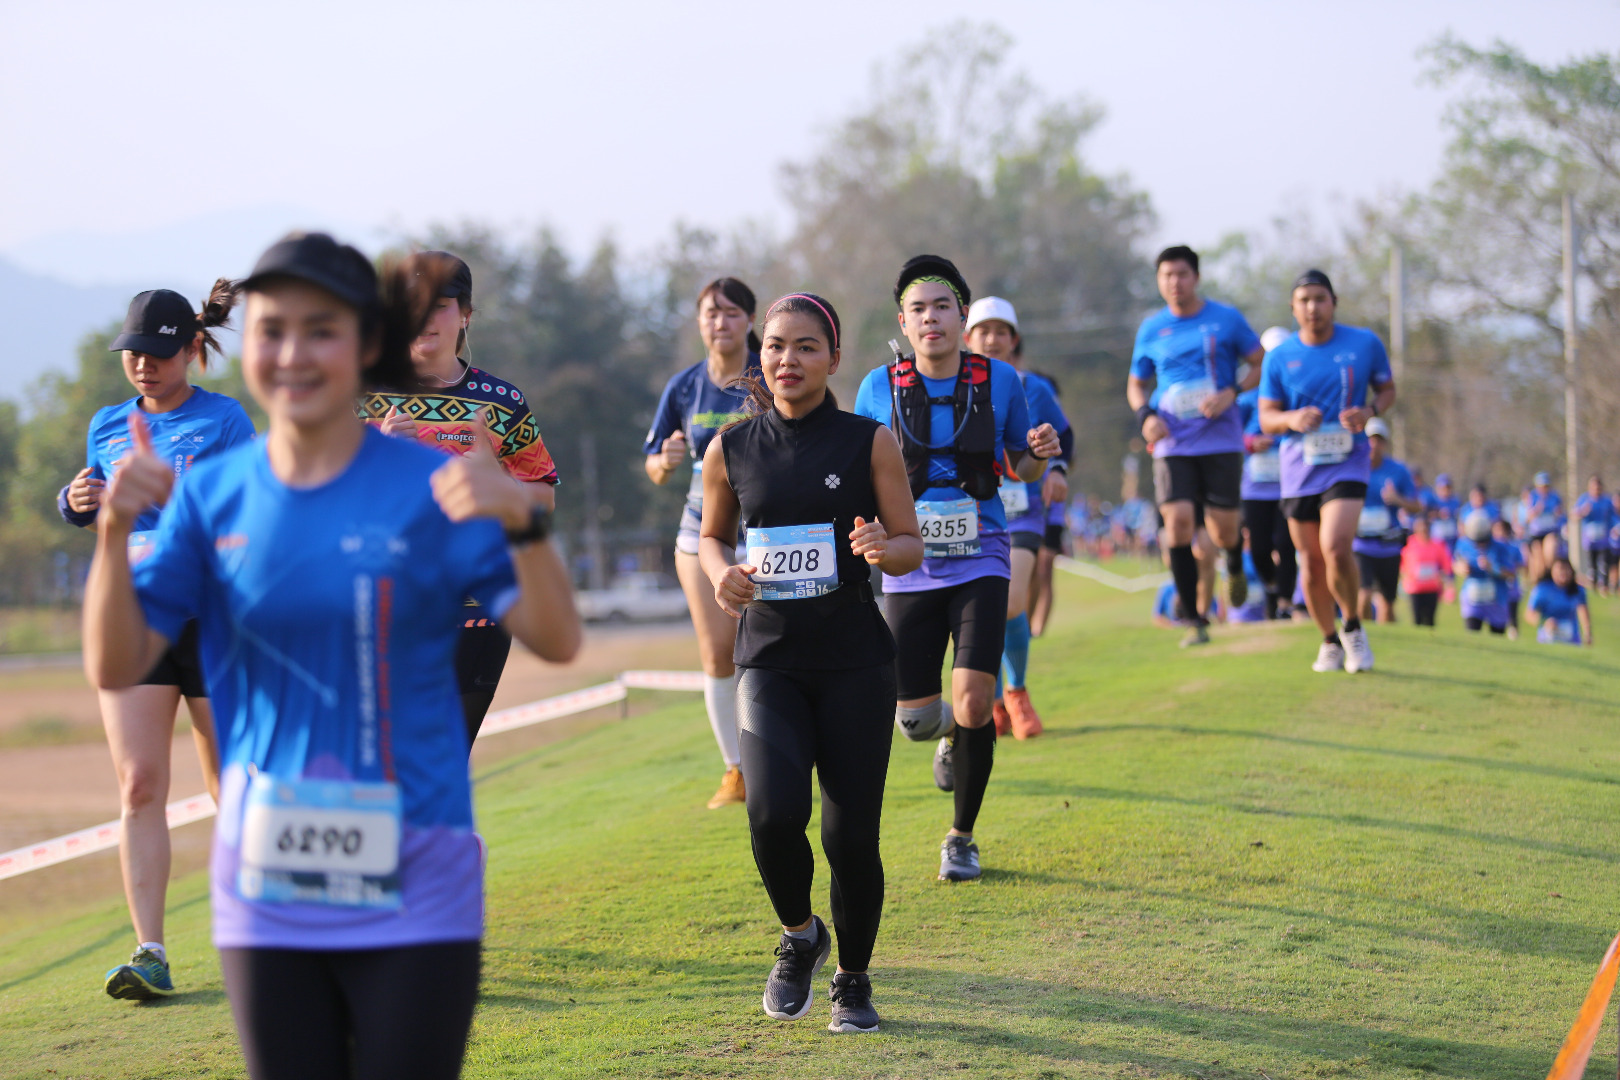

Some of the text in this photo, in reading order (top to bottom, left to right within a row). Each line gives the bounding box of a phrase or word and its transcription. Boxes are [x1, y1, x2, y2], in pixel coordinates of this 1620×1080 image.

[158, 325, 178, 335] Ari
[441, 434, 477, 442] PROJECT
[920, 518, 967, 538] 6355
[761, 548, 820, 575] 6208
[277, 826, 362, 857] 6290
